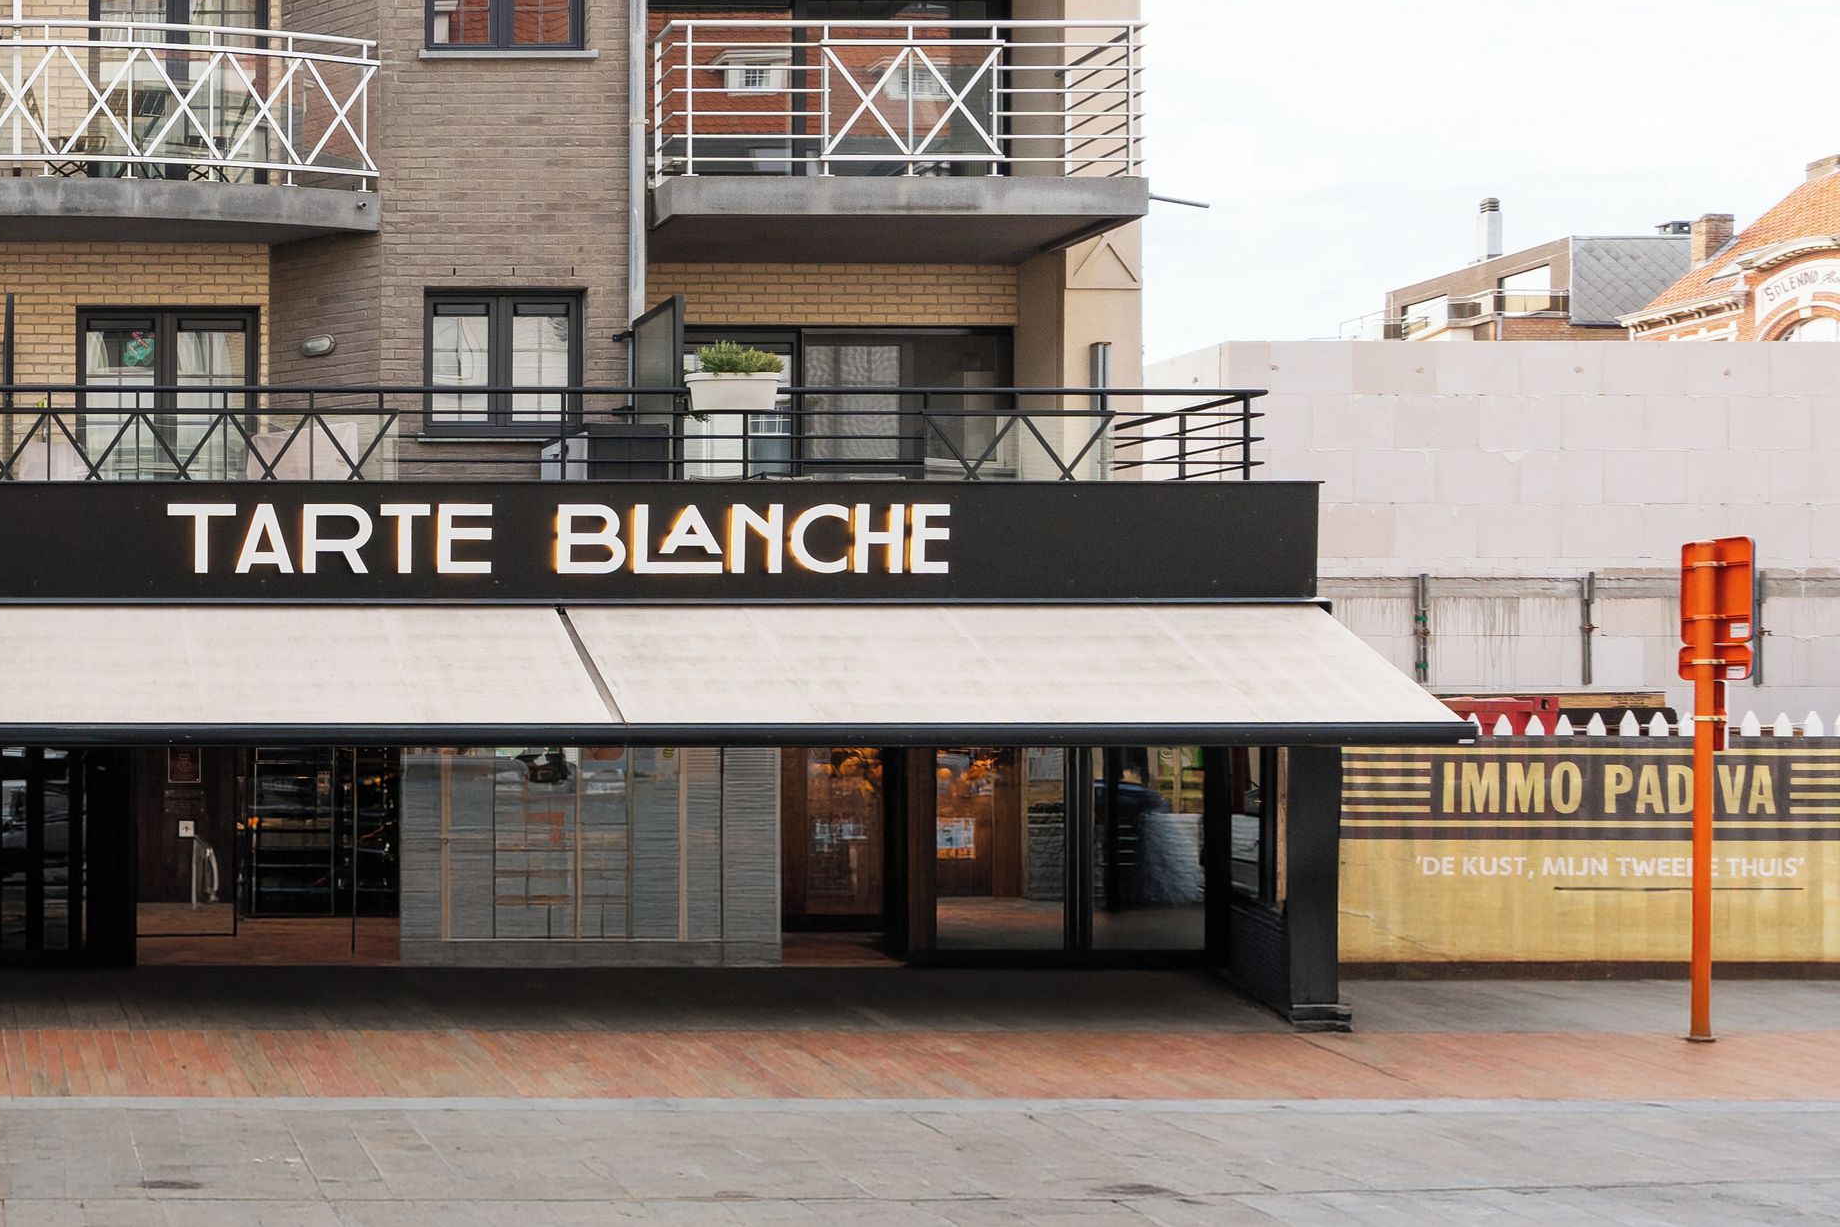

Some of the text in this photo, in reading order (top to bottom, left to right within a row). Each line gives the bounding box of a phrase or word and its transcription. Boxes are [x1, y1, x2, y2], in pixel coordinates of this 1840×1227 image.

[166, 503, 951, 574] TARTE BLANCHE
[1442, 761, 1777, 814] IMMO PADVA
[1462, 856, 1534, 880] KUST,
[1542, 856, 1608, 877] MIJN
